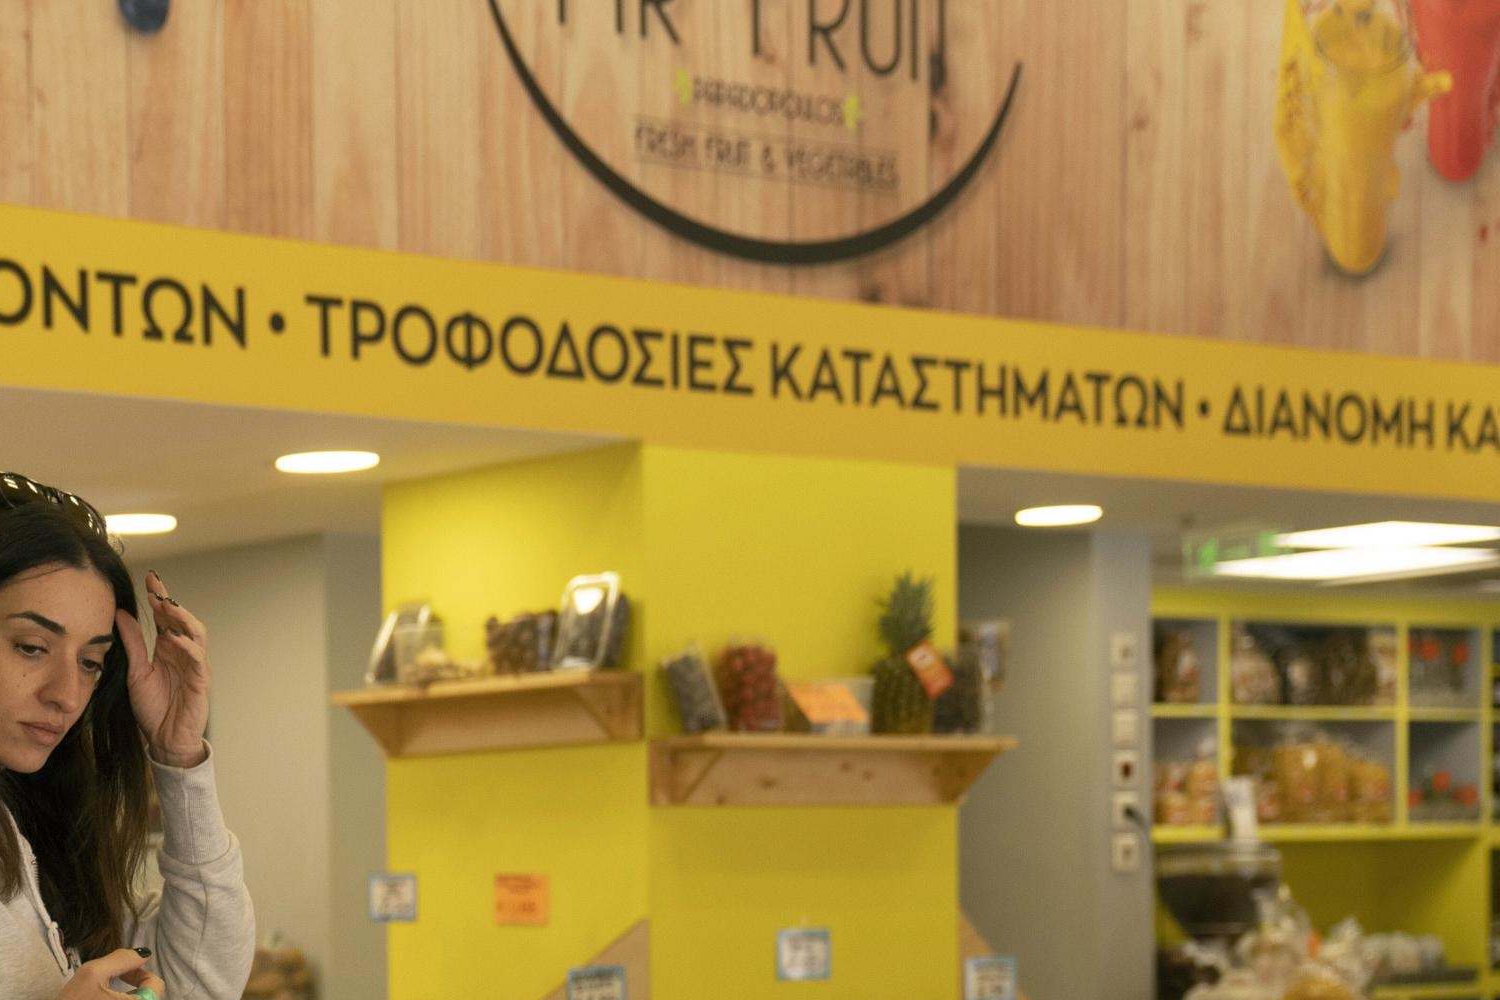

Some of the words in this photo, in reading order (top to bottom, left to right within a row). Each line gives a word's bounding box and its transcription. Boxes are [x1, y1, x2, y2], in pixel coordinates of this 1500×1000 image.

[305, 293, 756, 396] ΤΡΟΦΟΔΟΣΙΕΣ
[770, 342, 1186, 429] ΚΑΤΑΣΤΗΜΑΤΩΝ
[1223, 380, 1435, 449] ΔΙΑΝΟΜΗ
